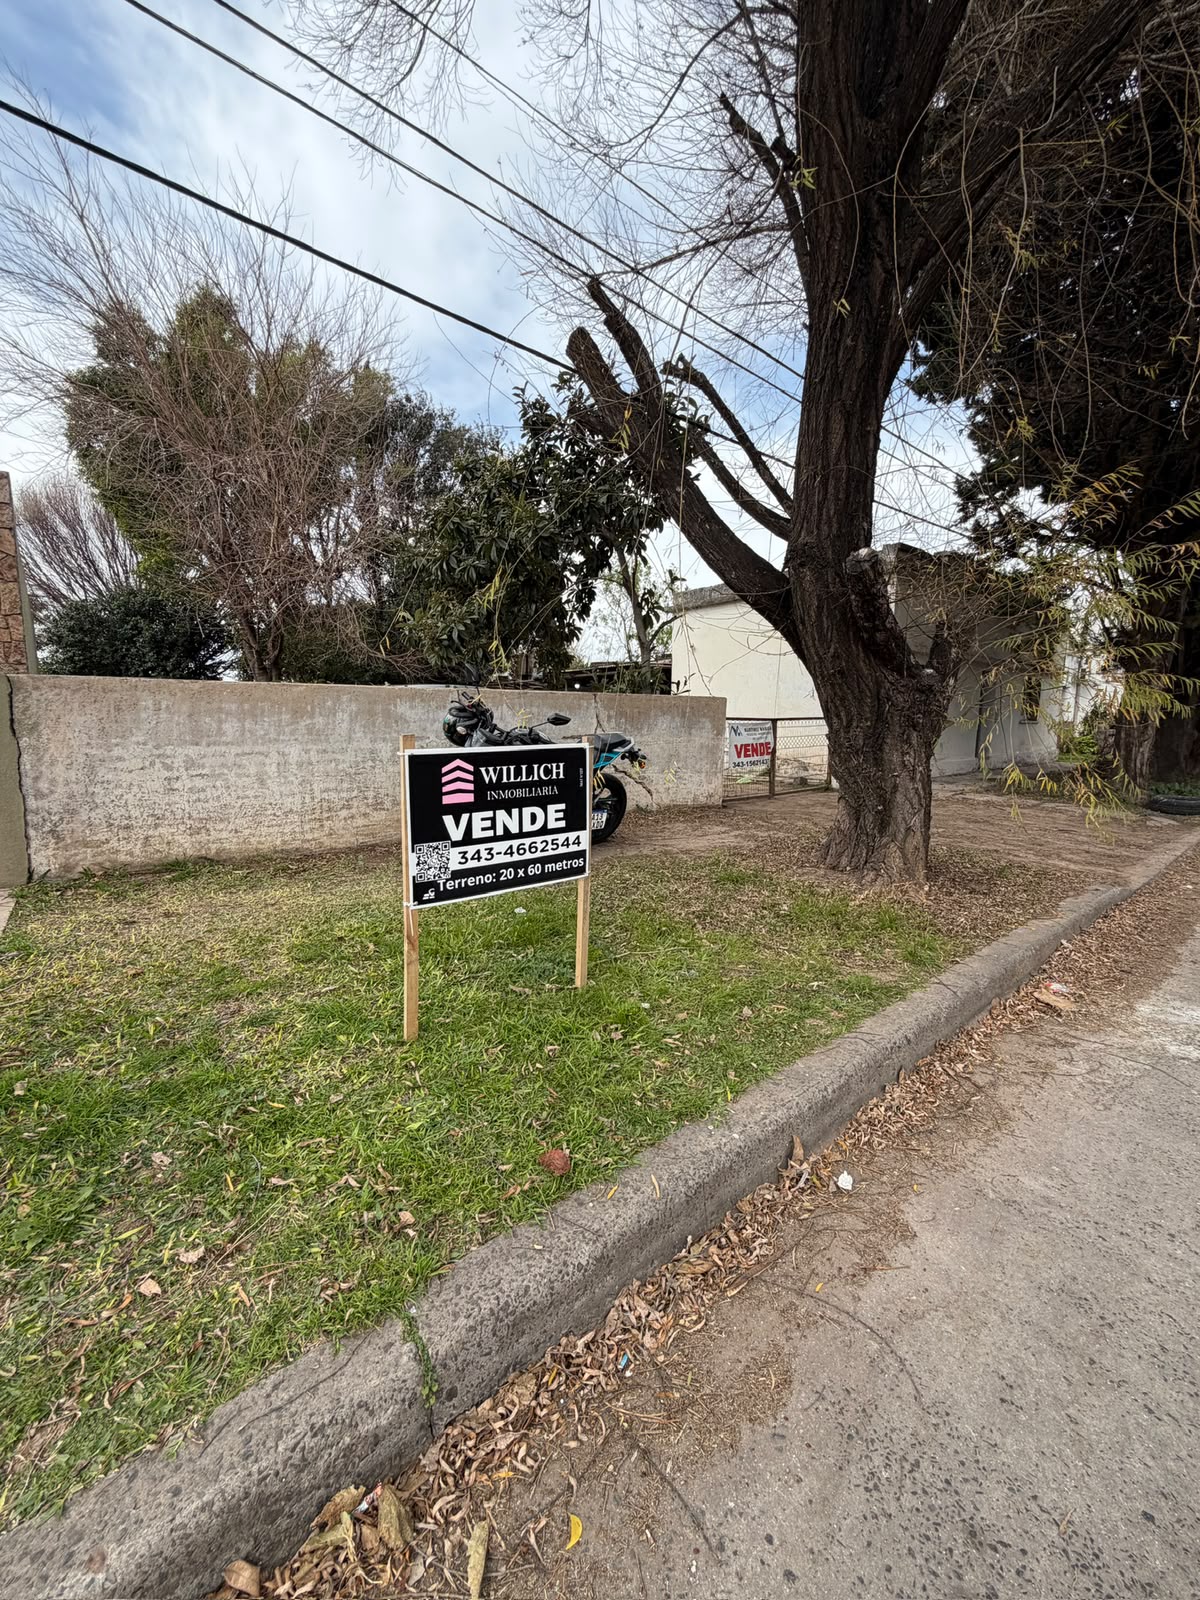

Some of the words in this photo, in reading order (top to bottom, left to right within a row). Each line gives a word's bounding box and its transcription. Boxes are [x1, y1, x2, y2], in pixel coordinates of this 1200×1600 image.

[734, 741, 771, 759] VENDE
[479, 762, 565, 784] WILLICH
[487, 785, 559, 800] INMOBILIARIA
[442, 803, 566, 842] VENDE
[457, 835, 582, 865] 343-4662544
[437, 873, 496, 892] Terreno:
[499, 868, 514, 881] 20
[517, 868, 525, 878] x
[527, 864, 542, 875] 60
[544, 857, 584, 872] metros
